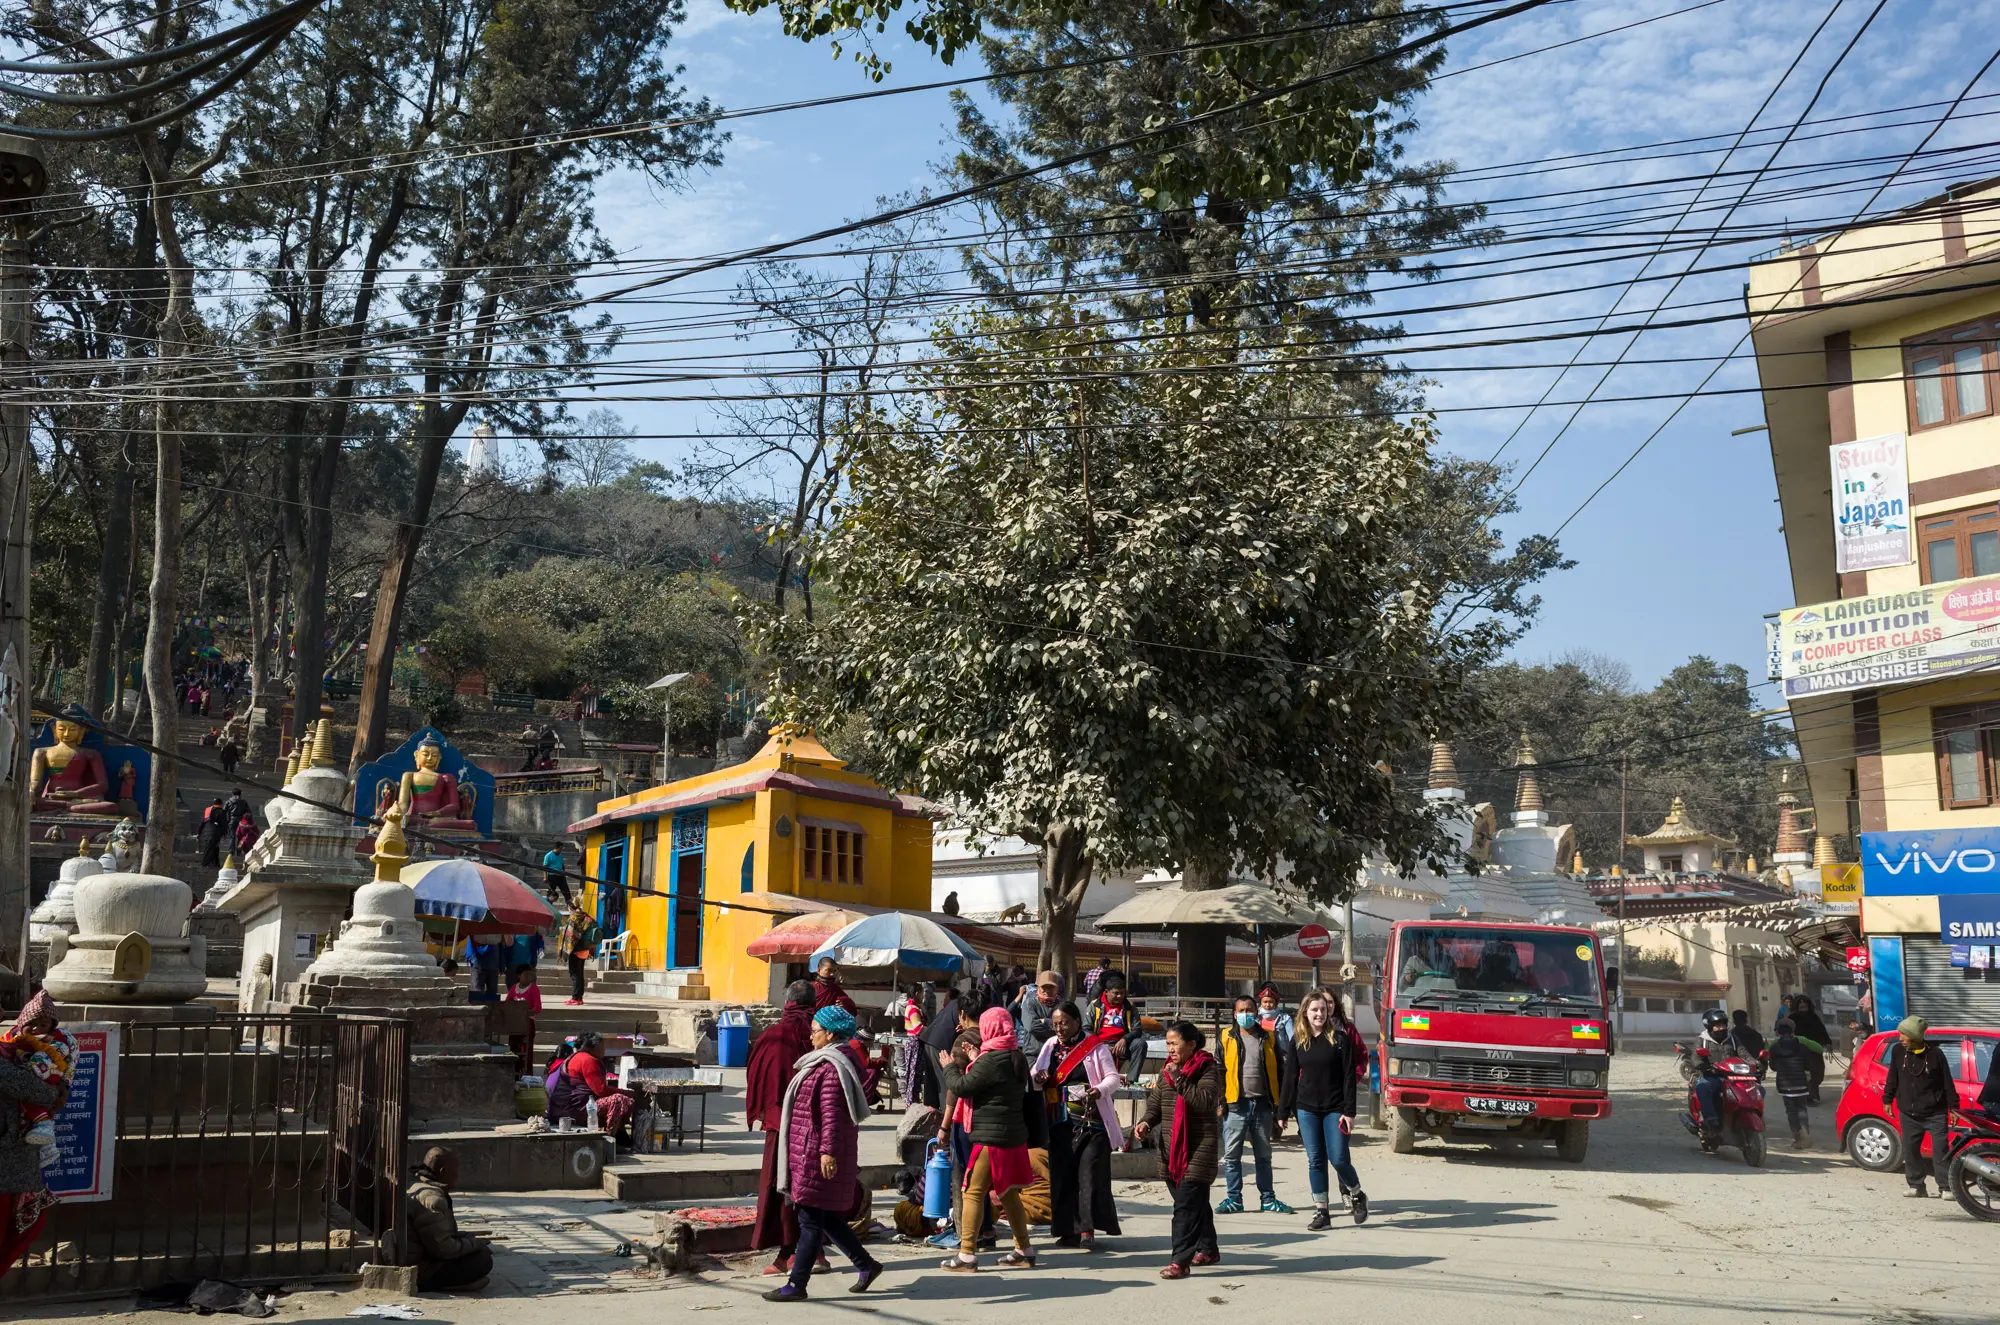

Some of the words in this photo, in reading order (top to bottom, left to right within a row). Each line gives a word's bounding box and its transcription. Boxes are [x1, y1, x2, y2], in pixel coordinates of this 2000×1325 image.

[1838, 441, 1900, 470] Study
[1844, 479, 1865, 495] in
[1839, 498, 1904, 526] Japan
[1847, 538, 1903, 555] Manjushree
[1823, 588, 1934, 622] LANGUAGE
[1825, 610, 1929, 639] TUITION
[1804, 635, 1886, 661] COMPUTER
[1891, 626, 1943, 648] CLASS
[1798, 662, 1825, 675] SLC
[1897, 646, 1928, 660] SEE
[1809, 660, 1930, 690] MANJUSHREE
[1964, 653, 1997, 666] academy
[1876, 841, 1996, 875] vivo
[1826, 883, 1857, 892] Kodak
[1826, 904, 1840, 912] Photo
[1849, 955, 1868, 966] 4G
[1485, 1050, 1515, 1060] TATA
[75, 1067, 96, 1076] स्मात
